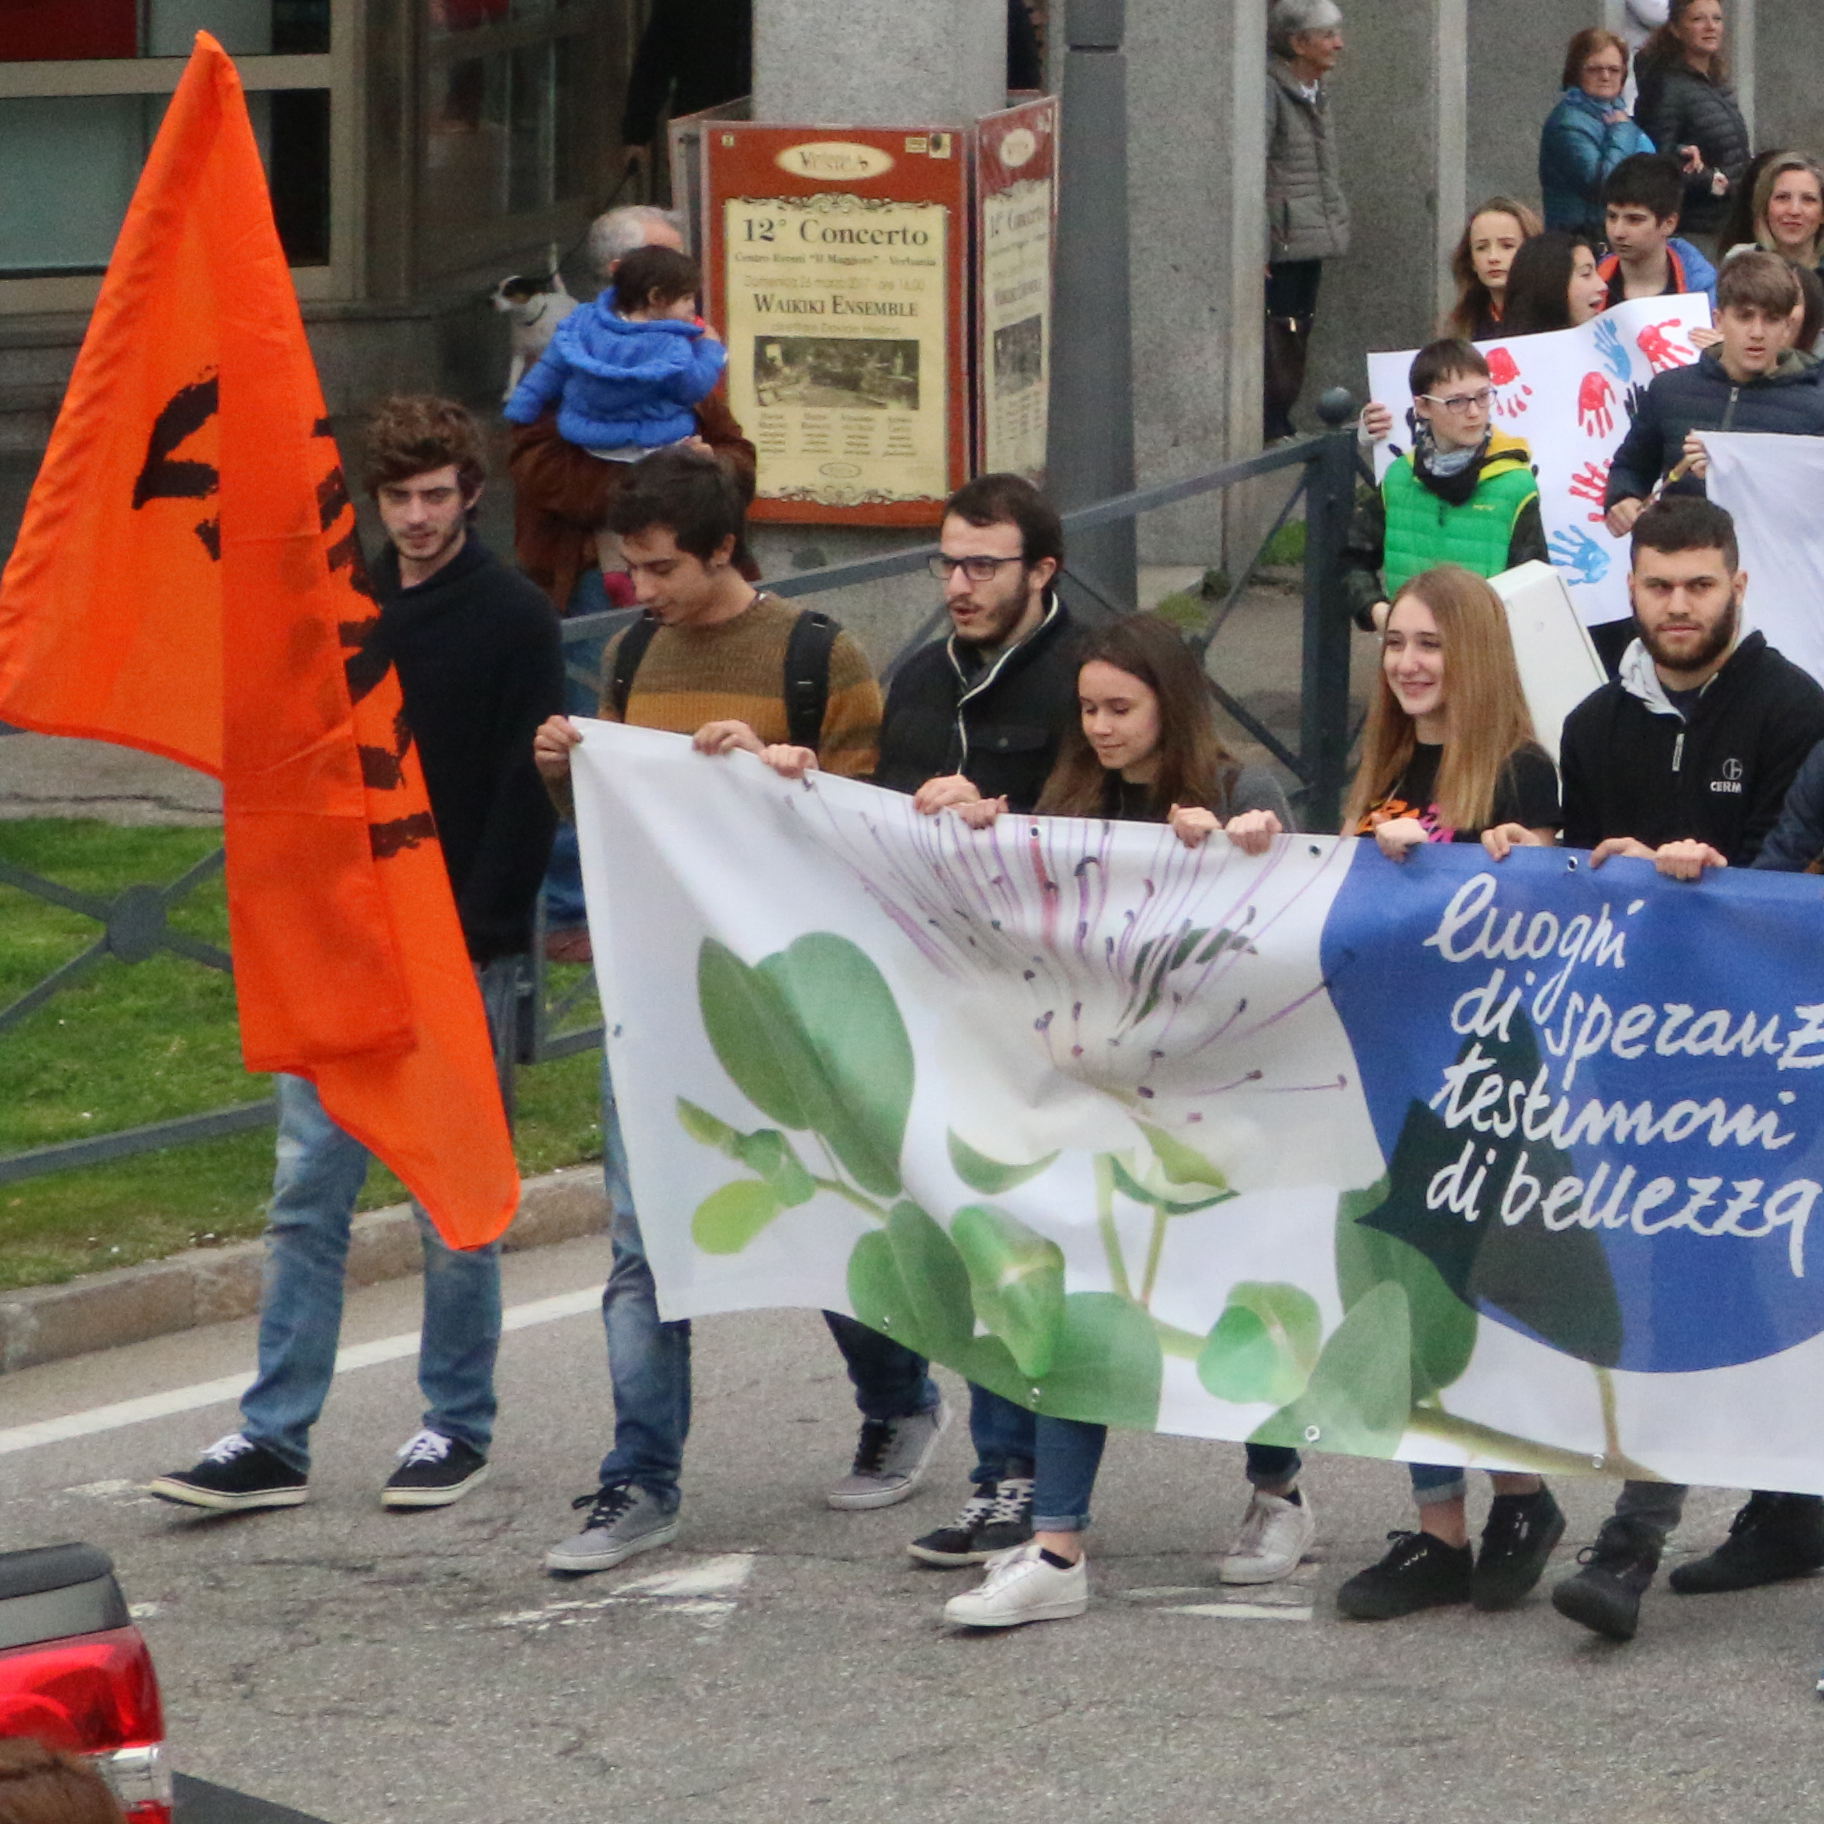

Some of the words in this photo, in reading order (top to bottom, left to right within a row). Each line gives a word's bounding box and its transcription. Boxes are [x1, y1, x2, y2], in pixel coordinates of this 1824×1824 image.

[799, 218, 929, 246] Concerto
[831, 294, 919, 317] ENSEMBLE
[1423, 873, 1646, 1027] luoghi
[1450, 967, 1537, 1043] di
[1429, 1042, 1797, 1151] testimoni
[1426, 1140, 1496, 1223] di
[1499, 1151, 1823, 1278] bellezza
